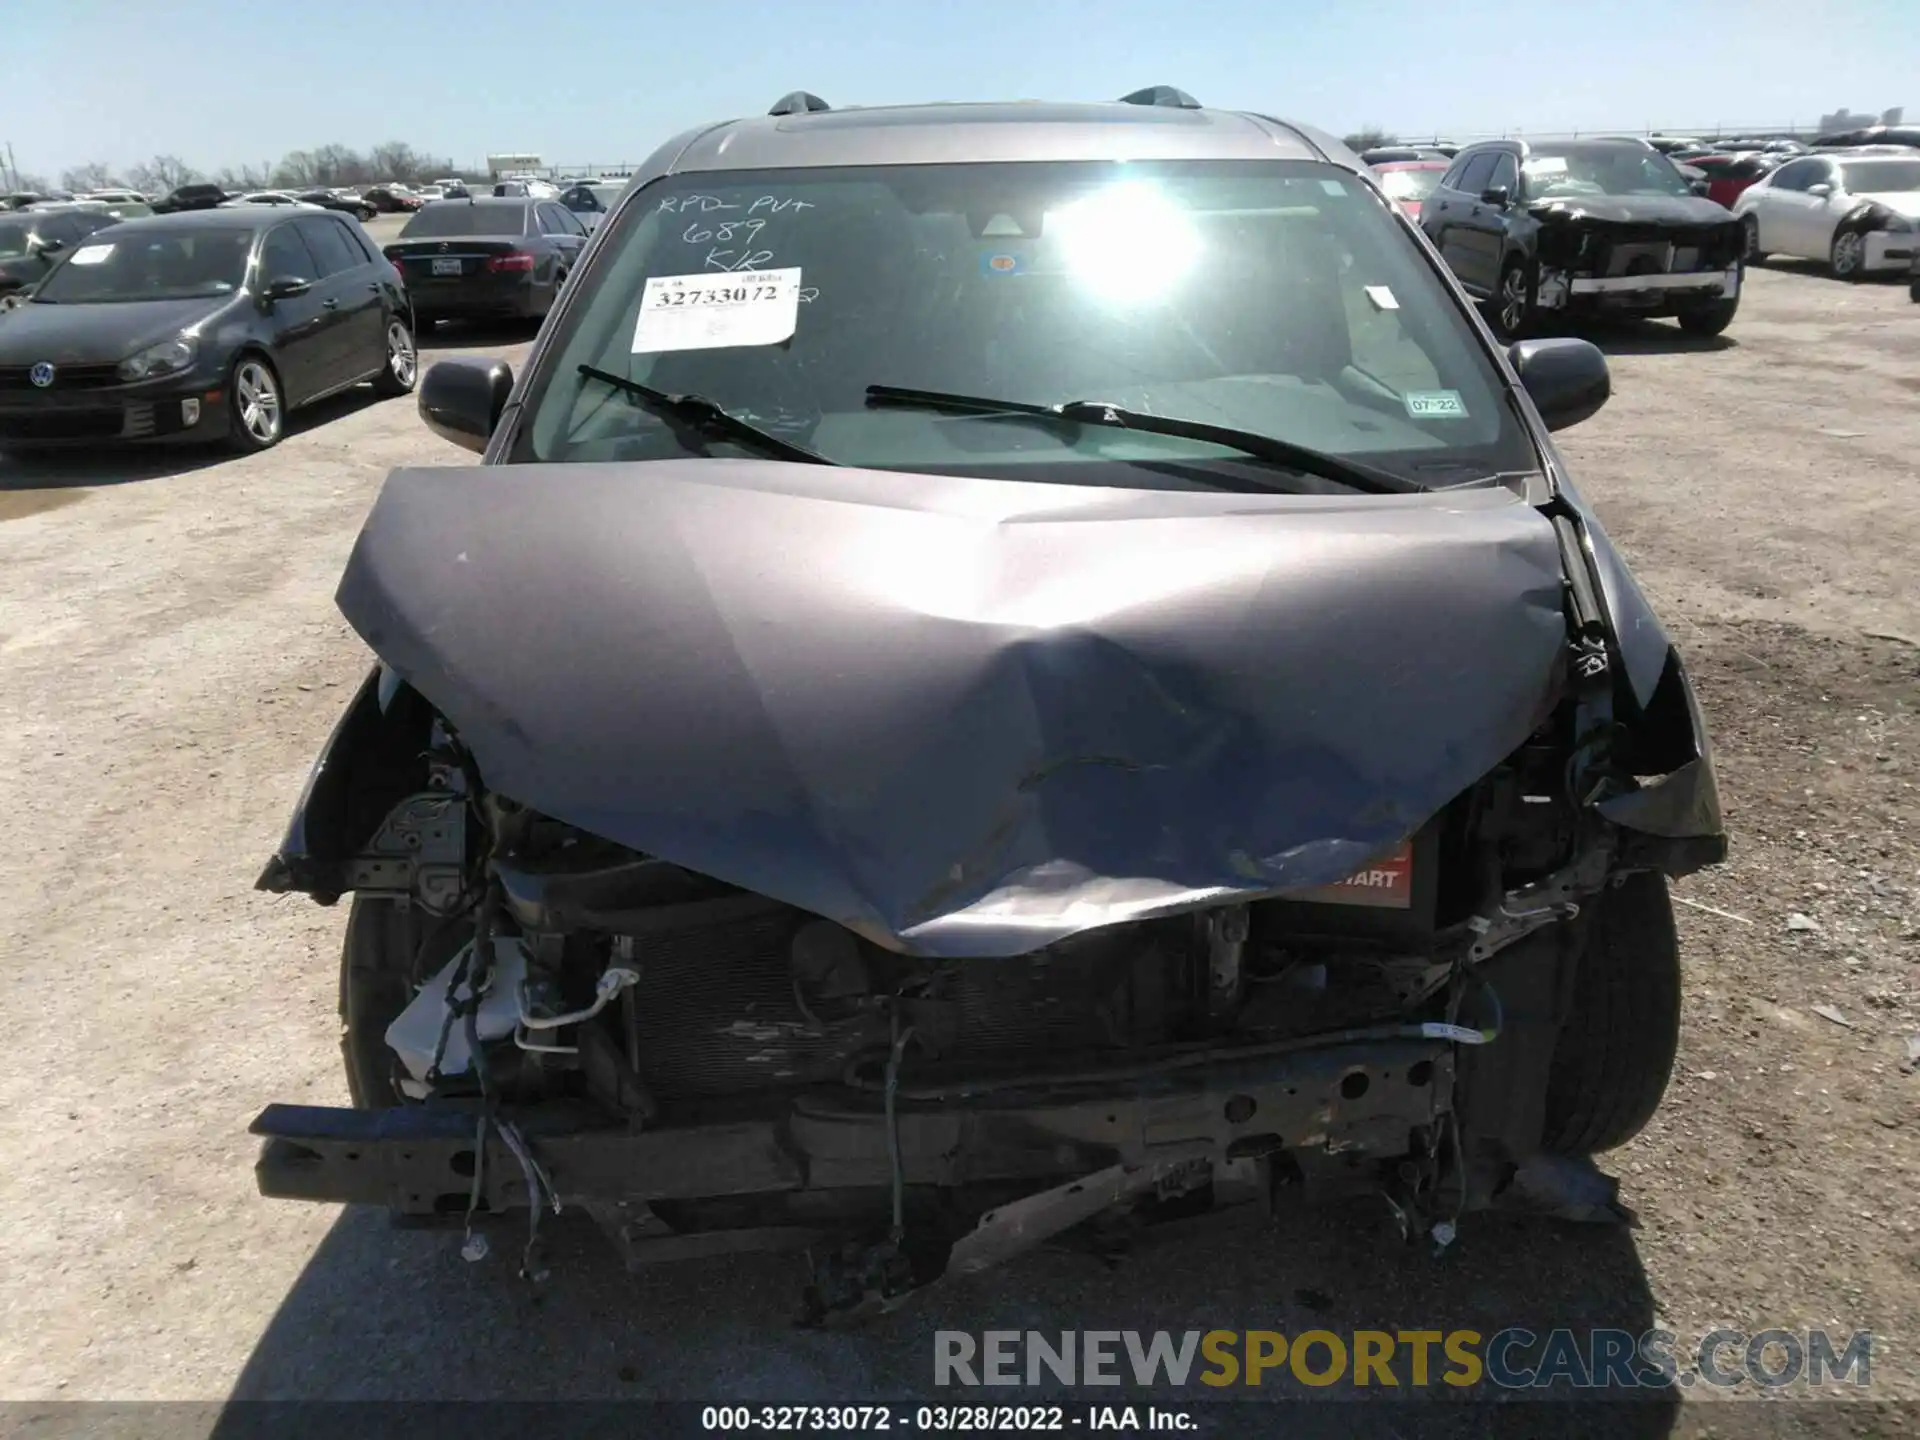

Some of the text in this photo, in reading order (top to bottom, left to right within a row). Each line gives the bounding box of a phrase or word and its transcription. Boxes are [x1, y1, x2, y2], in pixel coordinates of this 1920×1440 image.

[682, 219, 766, 244] 689
[1412, 400, 1457, 410] 07 22
